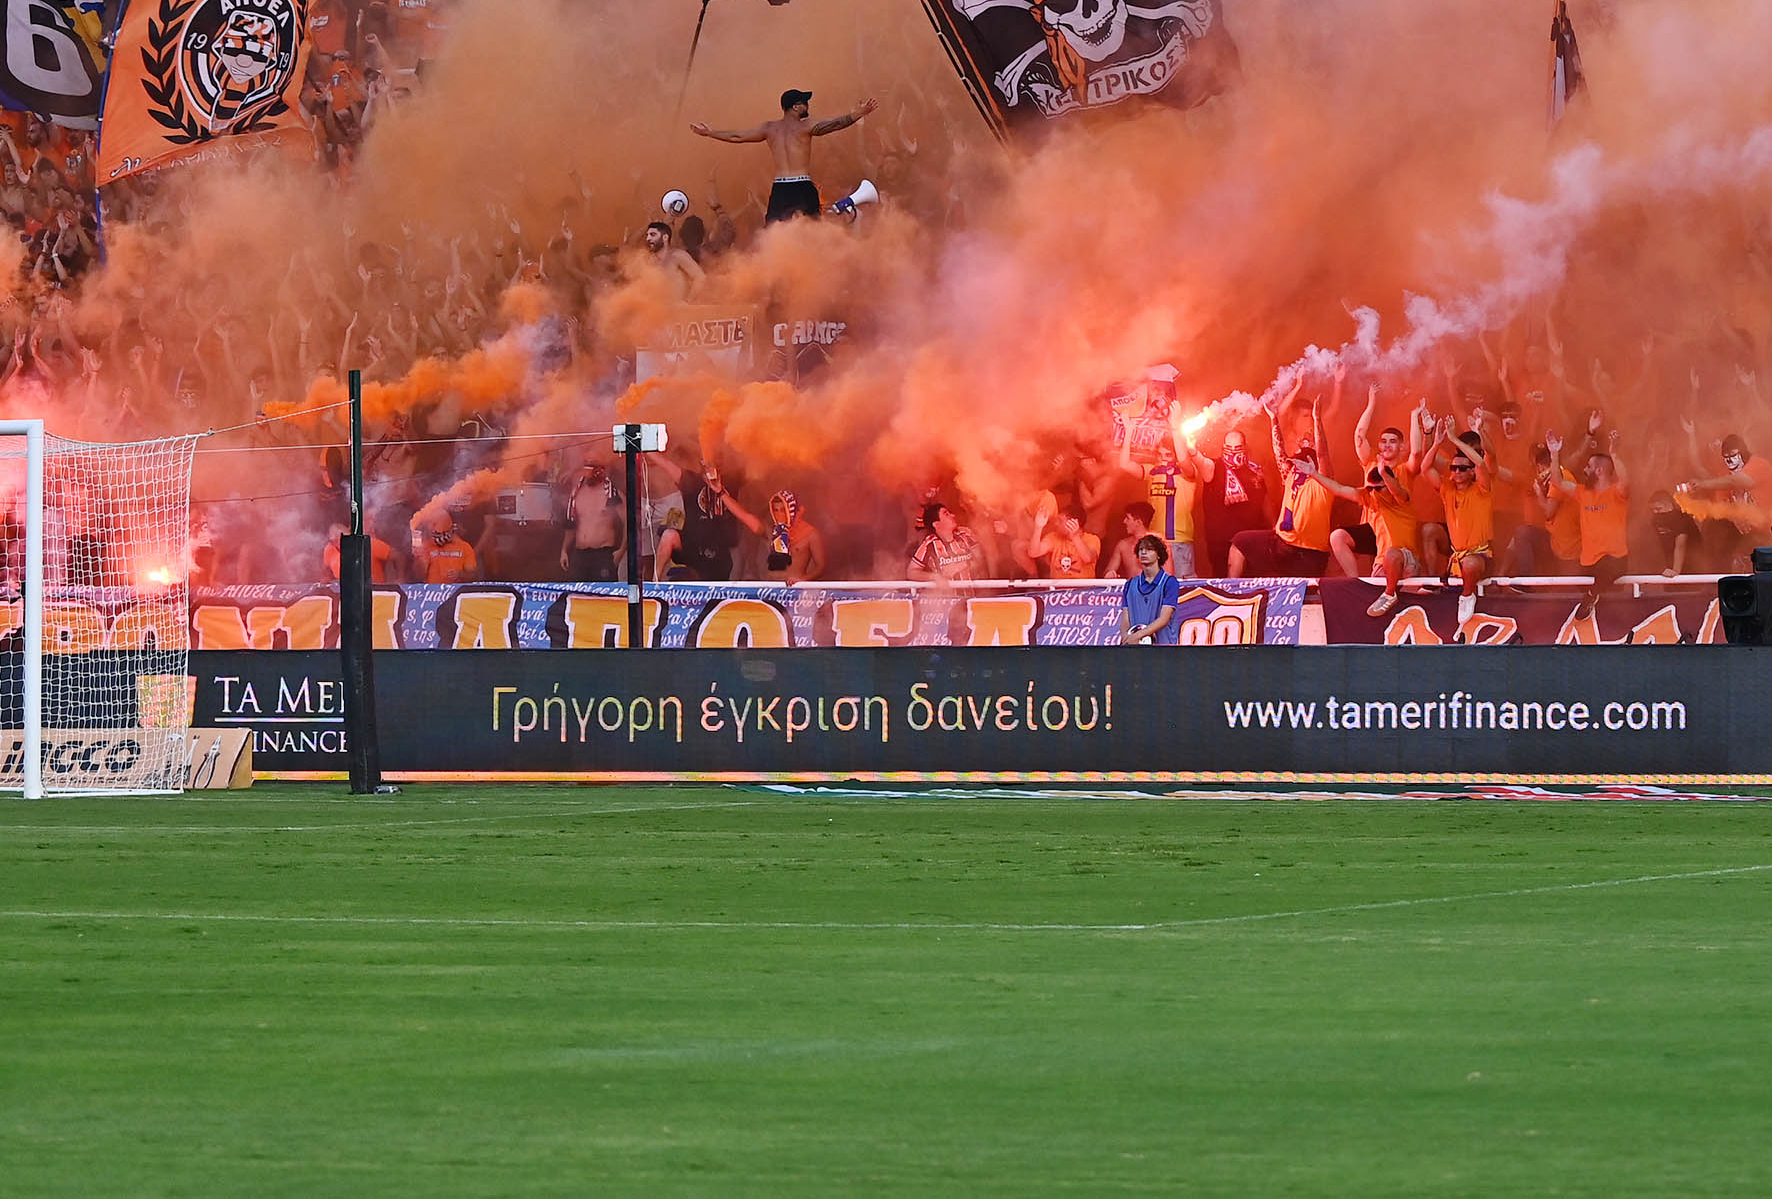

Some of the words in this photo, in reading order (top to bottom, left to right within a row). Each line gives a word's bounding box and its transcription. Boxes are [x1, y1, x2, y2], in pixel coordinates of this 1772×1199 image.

[186, 32, 208, 50] 19
[1043, 53, 1183, 112] ΚΕΤΡΙΚΟΣ
[492, 682, 684, 743] Γρήγορη
[700, 682, 889, 743] έγκριση
[906, 680, 1114, 731] δανείου!
[1224, 690, 1688, 732] www.tamerifinance.com
